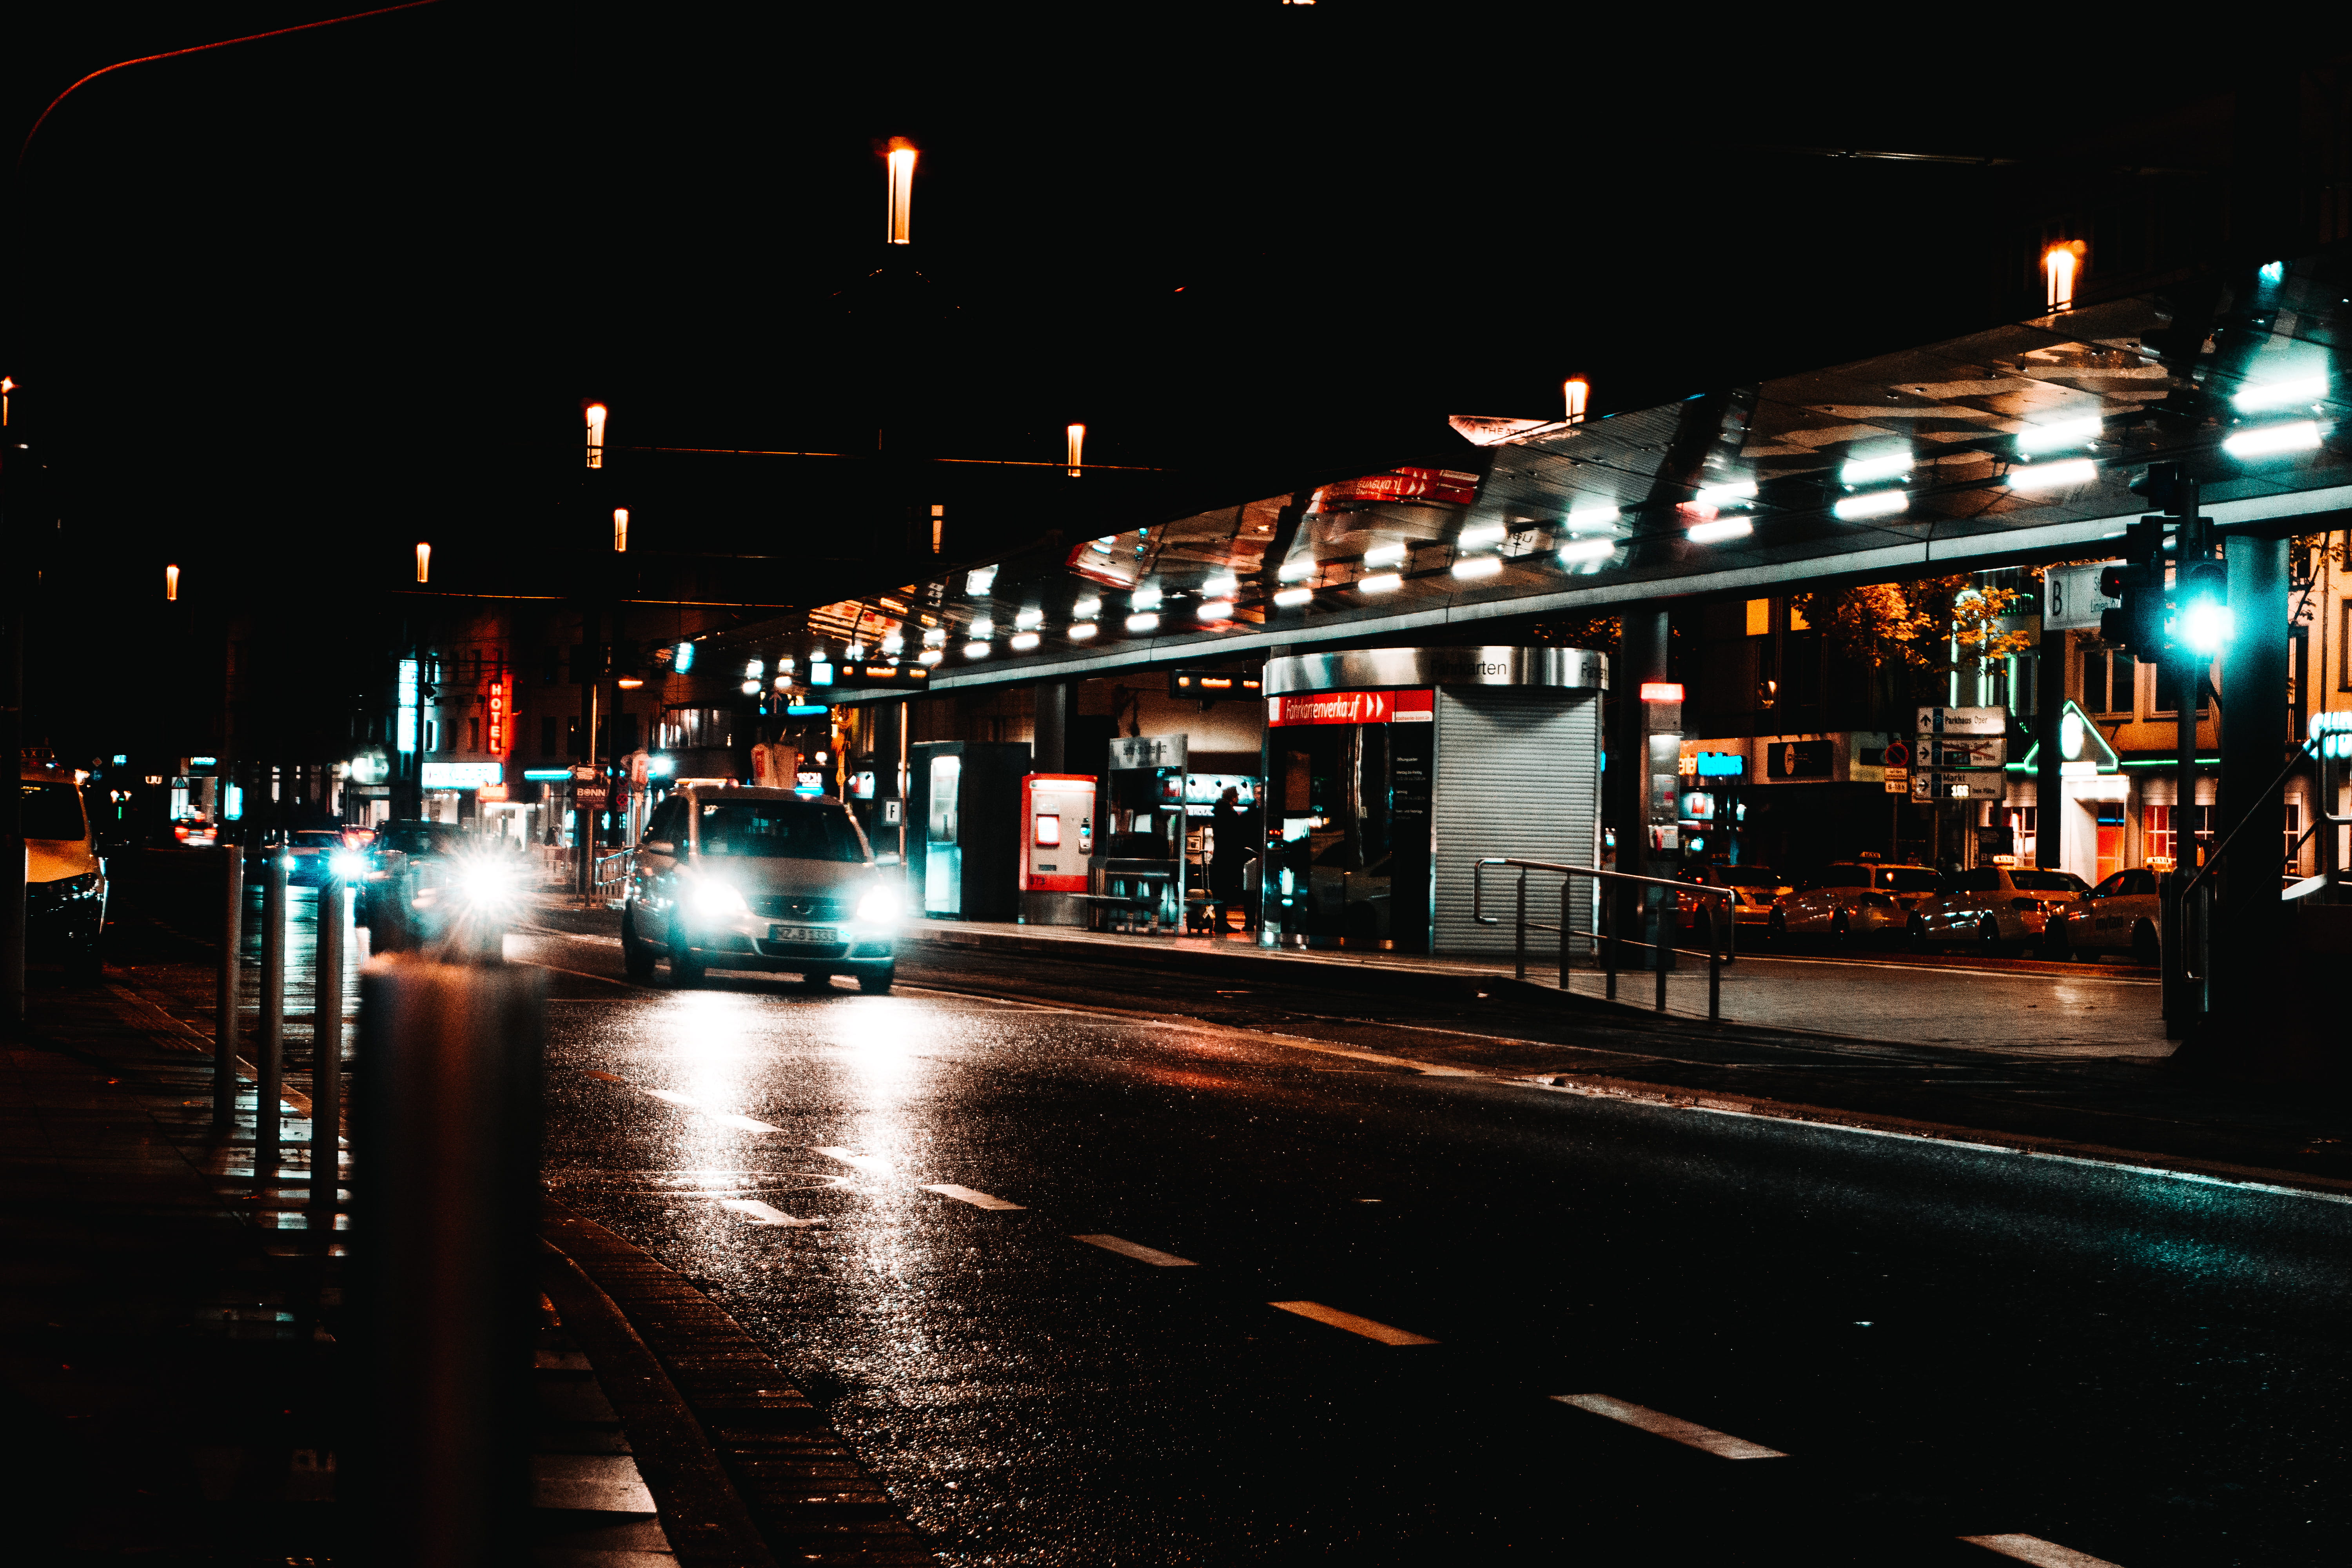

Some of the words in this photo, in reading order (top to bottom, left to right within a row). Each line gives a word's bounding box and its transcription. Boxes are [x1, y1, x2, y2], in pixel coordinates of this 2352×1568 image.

[1431, 660, 1506, 675] Fahrkarten
[490, 684, 502, 752] HOTEL
[1945, 716, 1971, 724] Parkhaus
[1974, 716, 1988, 725] Oper
[890, 805, 895, 818] F
